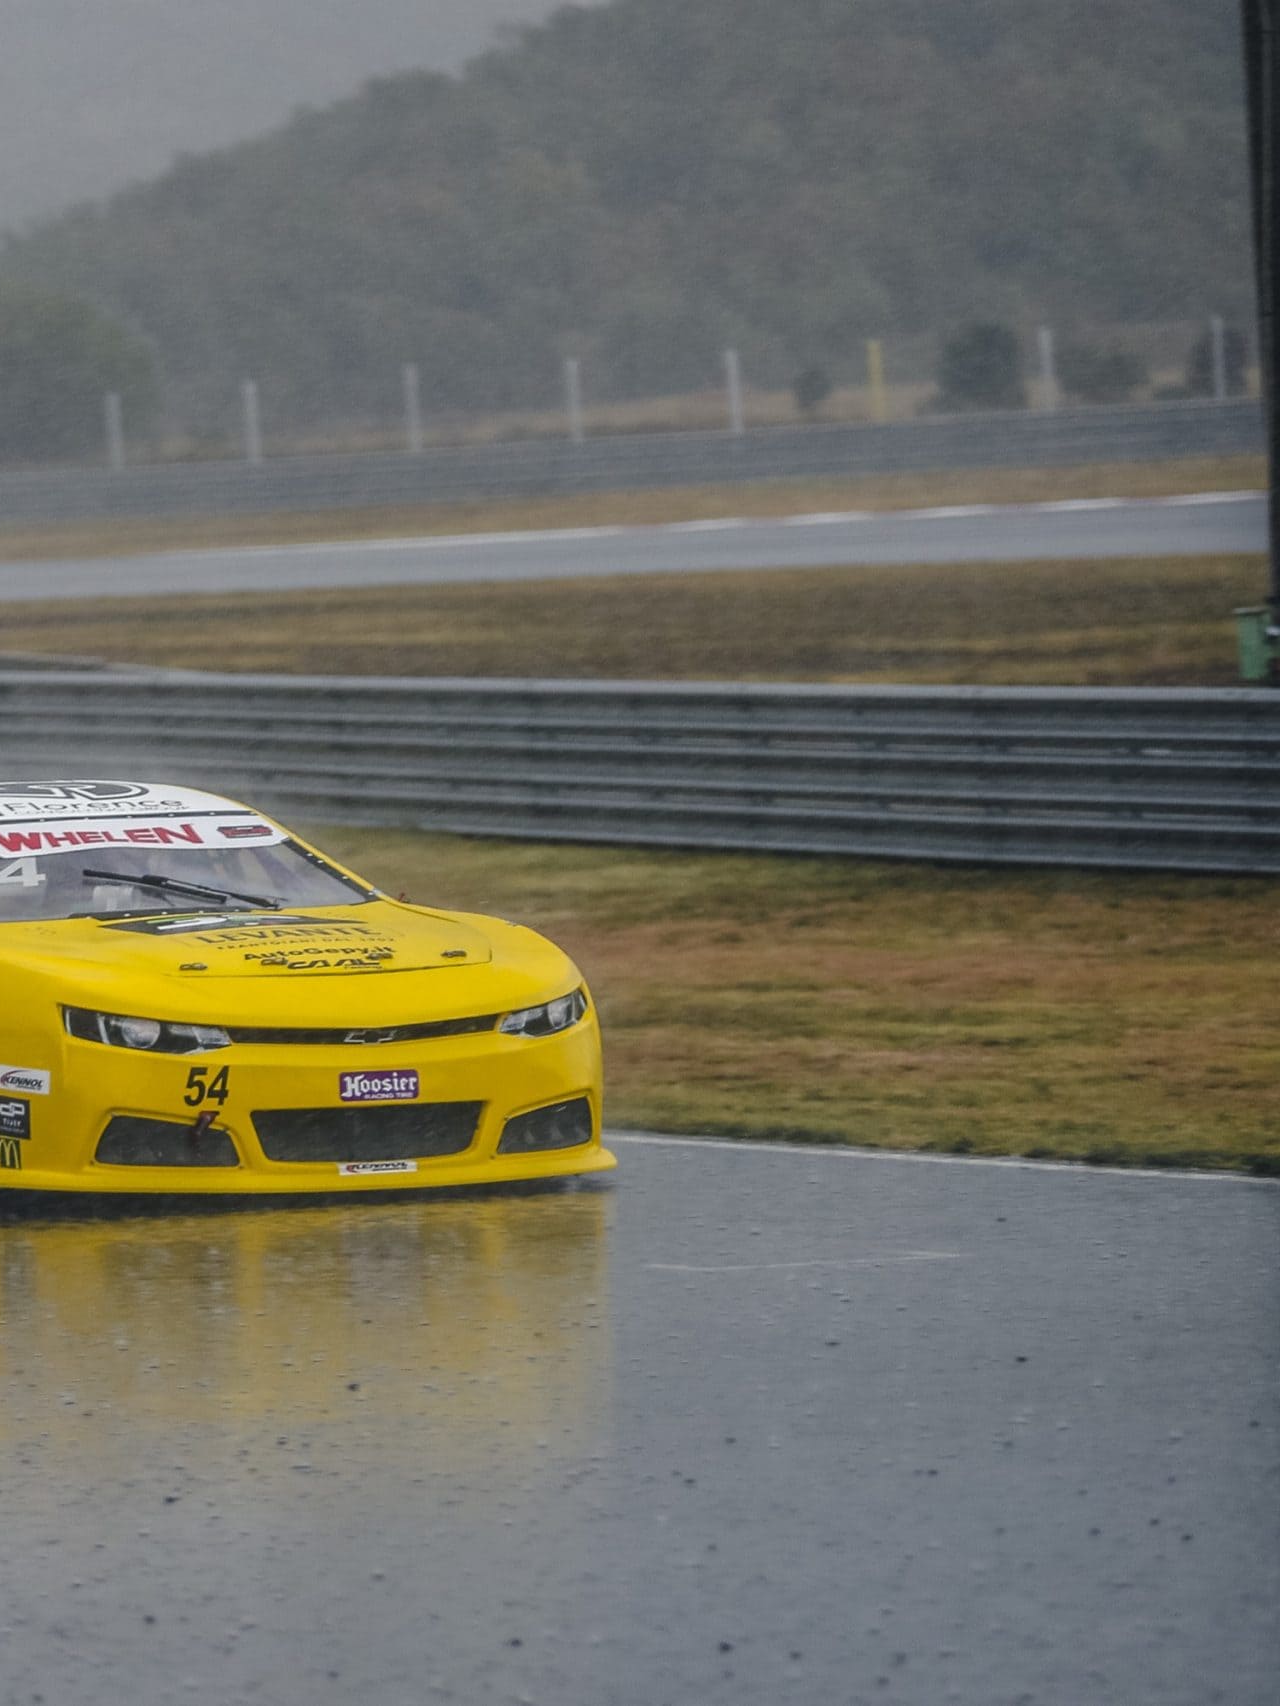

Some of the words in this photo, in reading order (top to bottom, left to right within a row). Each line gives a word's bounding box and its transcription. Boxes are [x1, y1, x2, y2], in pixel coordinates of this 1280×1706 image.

[3, 799, 183, 812] Florence
[195, 926, 382, 944] LEVANTE
[5, 1075, 44, 1089] KENNOL
[183, 1065, 230, 1107] 54
[340, 1071, 418, 1097] Hoosier
